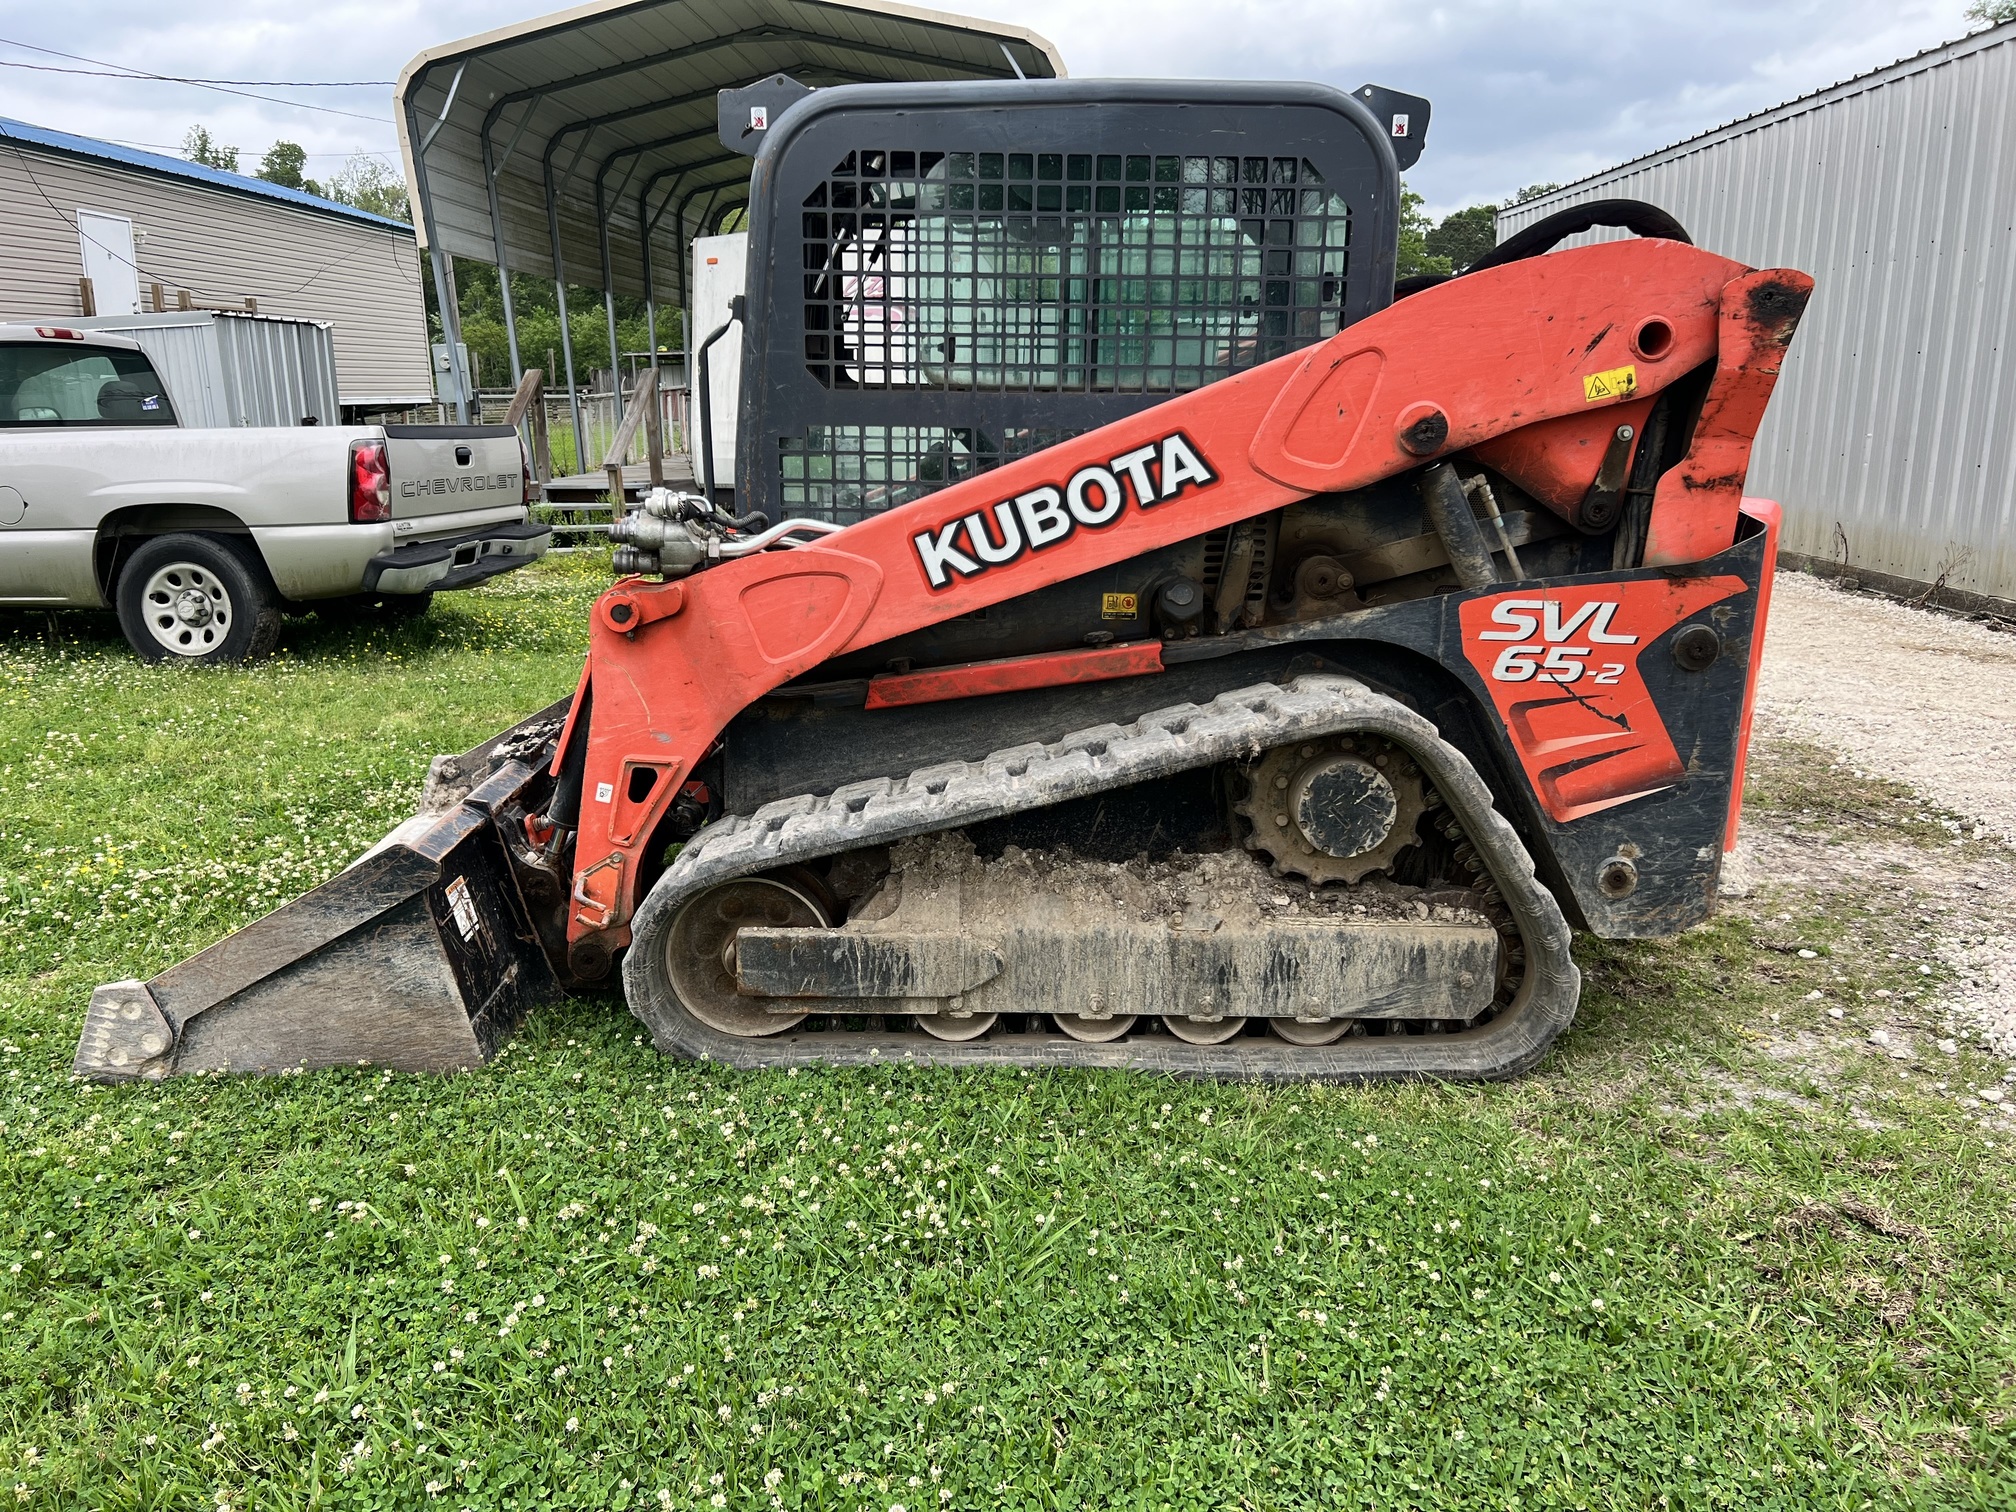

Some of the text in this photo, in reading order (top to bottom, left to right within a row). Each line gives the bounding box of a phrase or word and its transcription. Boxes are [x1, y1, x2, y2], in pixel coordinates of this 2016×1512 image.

[400, 473, 518, 498] CHEVROLET
[912, 432, 1215, 590] KUBOTA
[1477, 598, 1640, 645] SVL
[1491, 645, 1626, 685] 65-2
